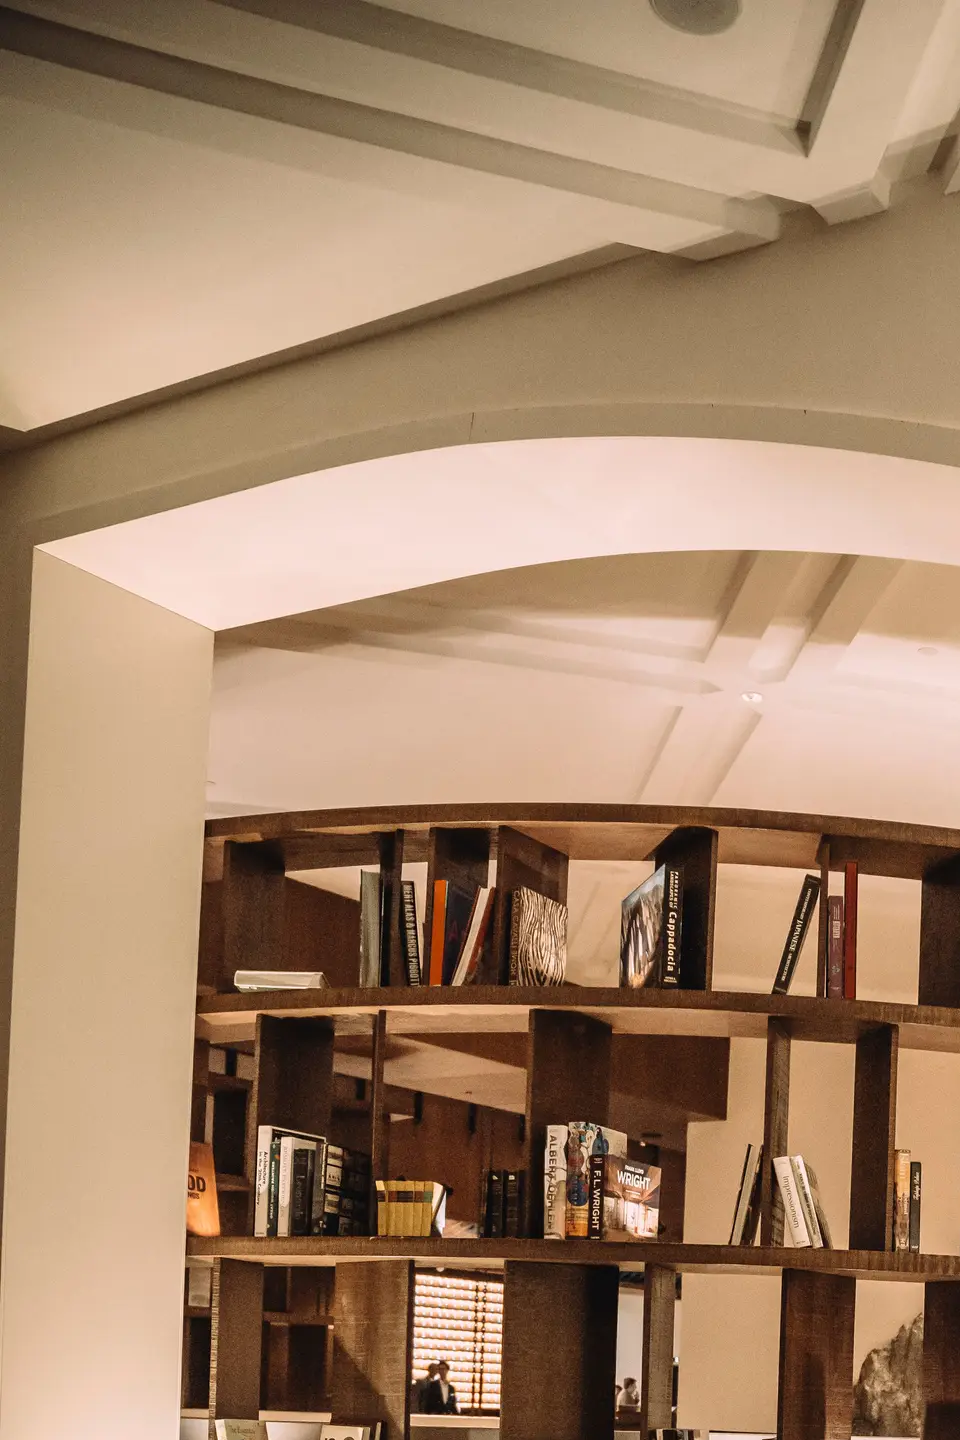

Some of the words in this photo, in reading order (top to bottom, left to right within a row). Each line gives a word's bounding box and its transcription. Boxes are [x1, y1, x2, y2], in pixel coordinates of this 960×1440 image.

[406, 929, 418, 957] MARCUS
[667, 911, 678, 972] Cappadocia
[788, 919, 804, 952] JAPANESE
[408, 958, 420, 987] PIGGOTT
[617, 1169, 651, 1190] WRIGHT
[782, 1175, 800, 1229] Impressionism
